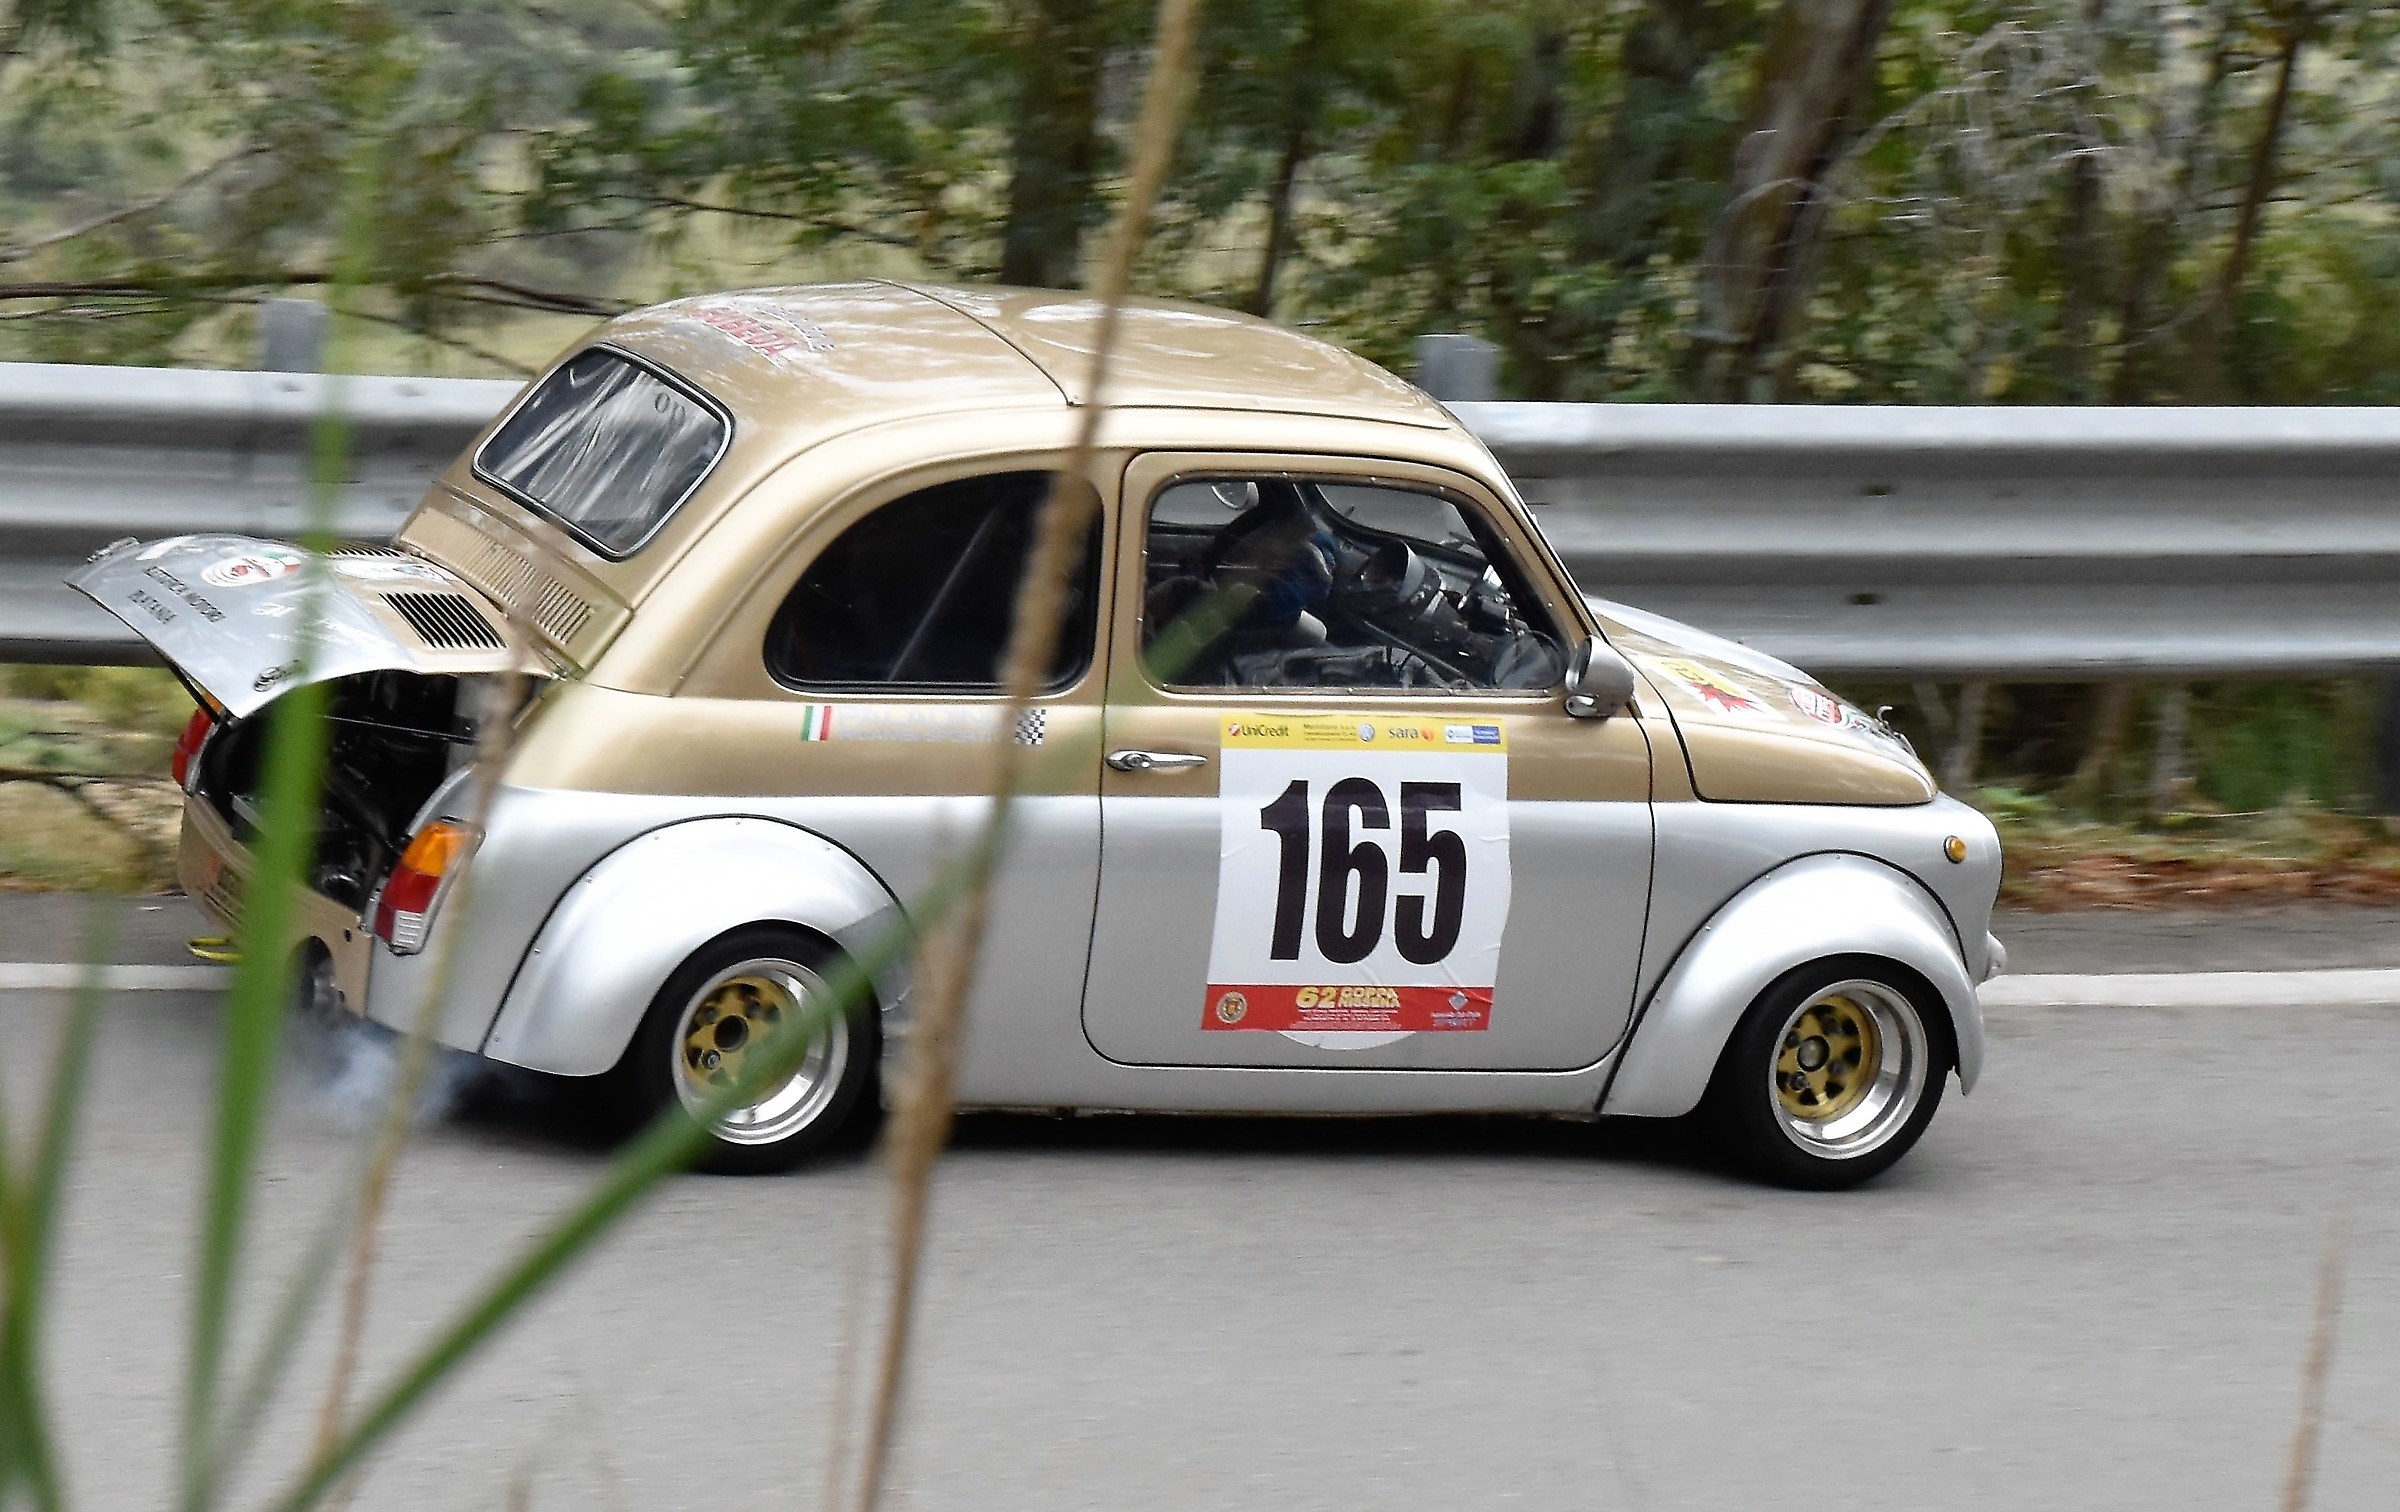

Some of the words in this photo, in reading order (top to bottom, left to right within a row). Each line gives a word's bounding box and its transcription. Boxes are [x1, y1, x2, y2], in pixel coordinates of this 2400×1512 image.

[1241, 723, 1289, 738] UniCredit
[1389, 726, 1419, 739] sara
[1260, 777, 1467, 965] 165
[1296, 987, 1337, 1008] 62
